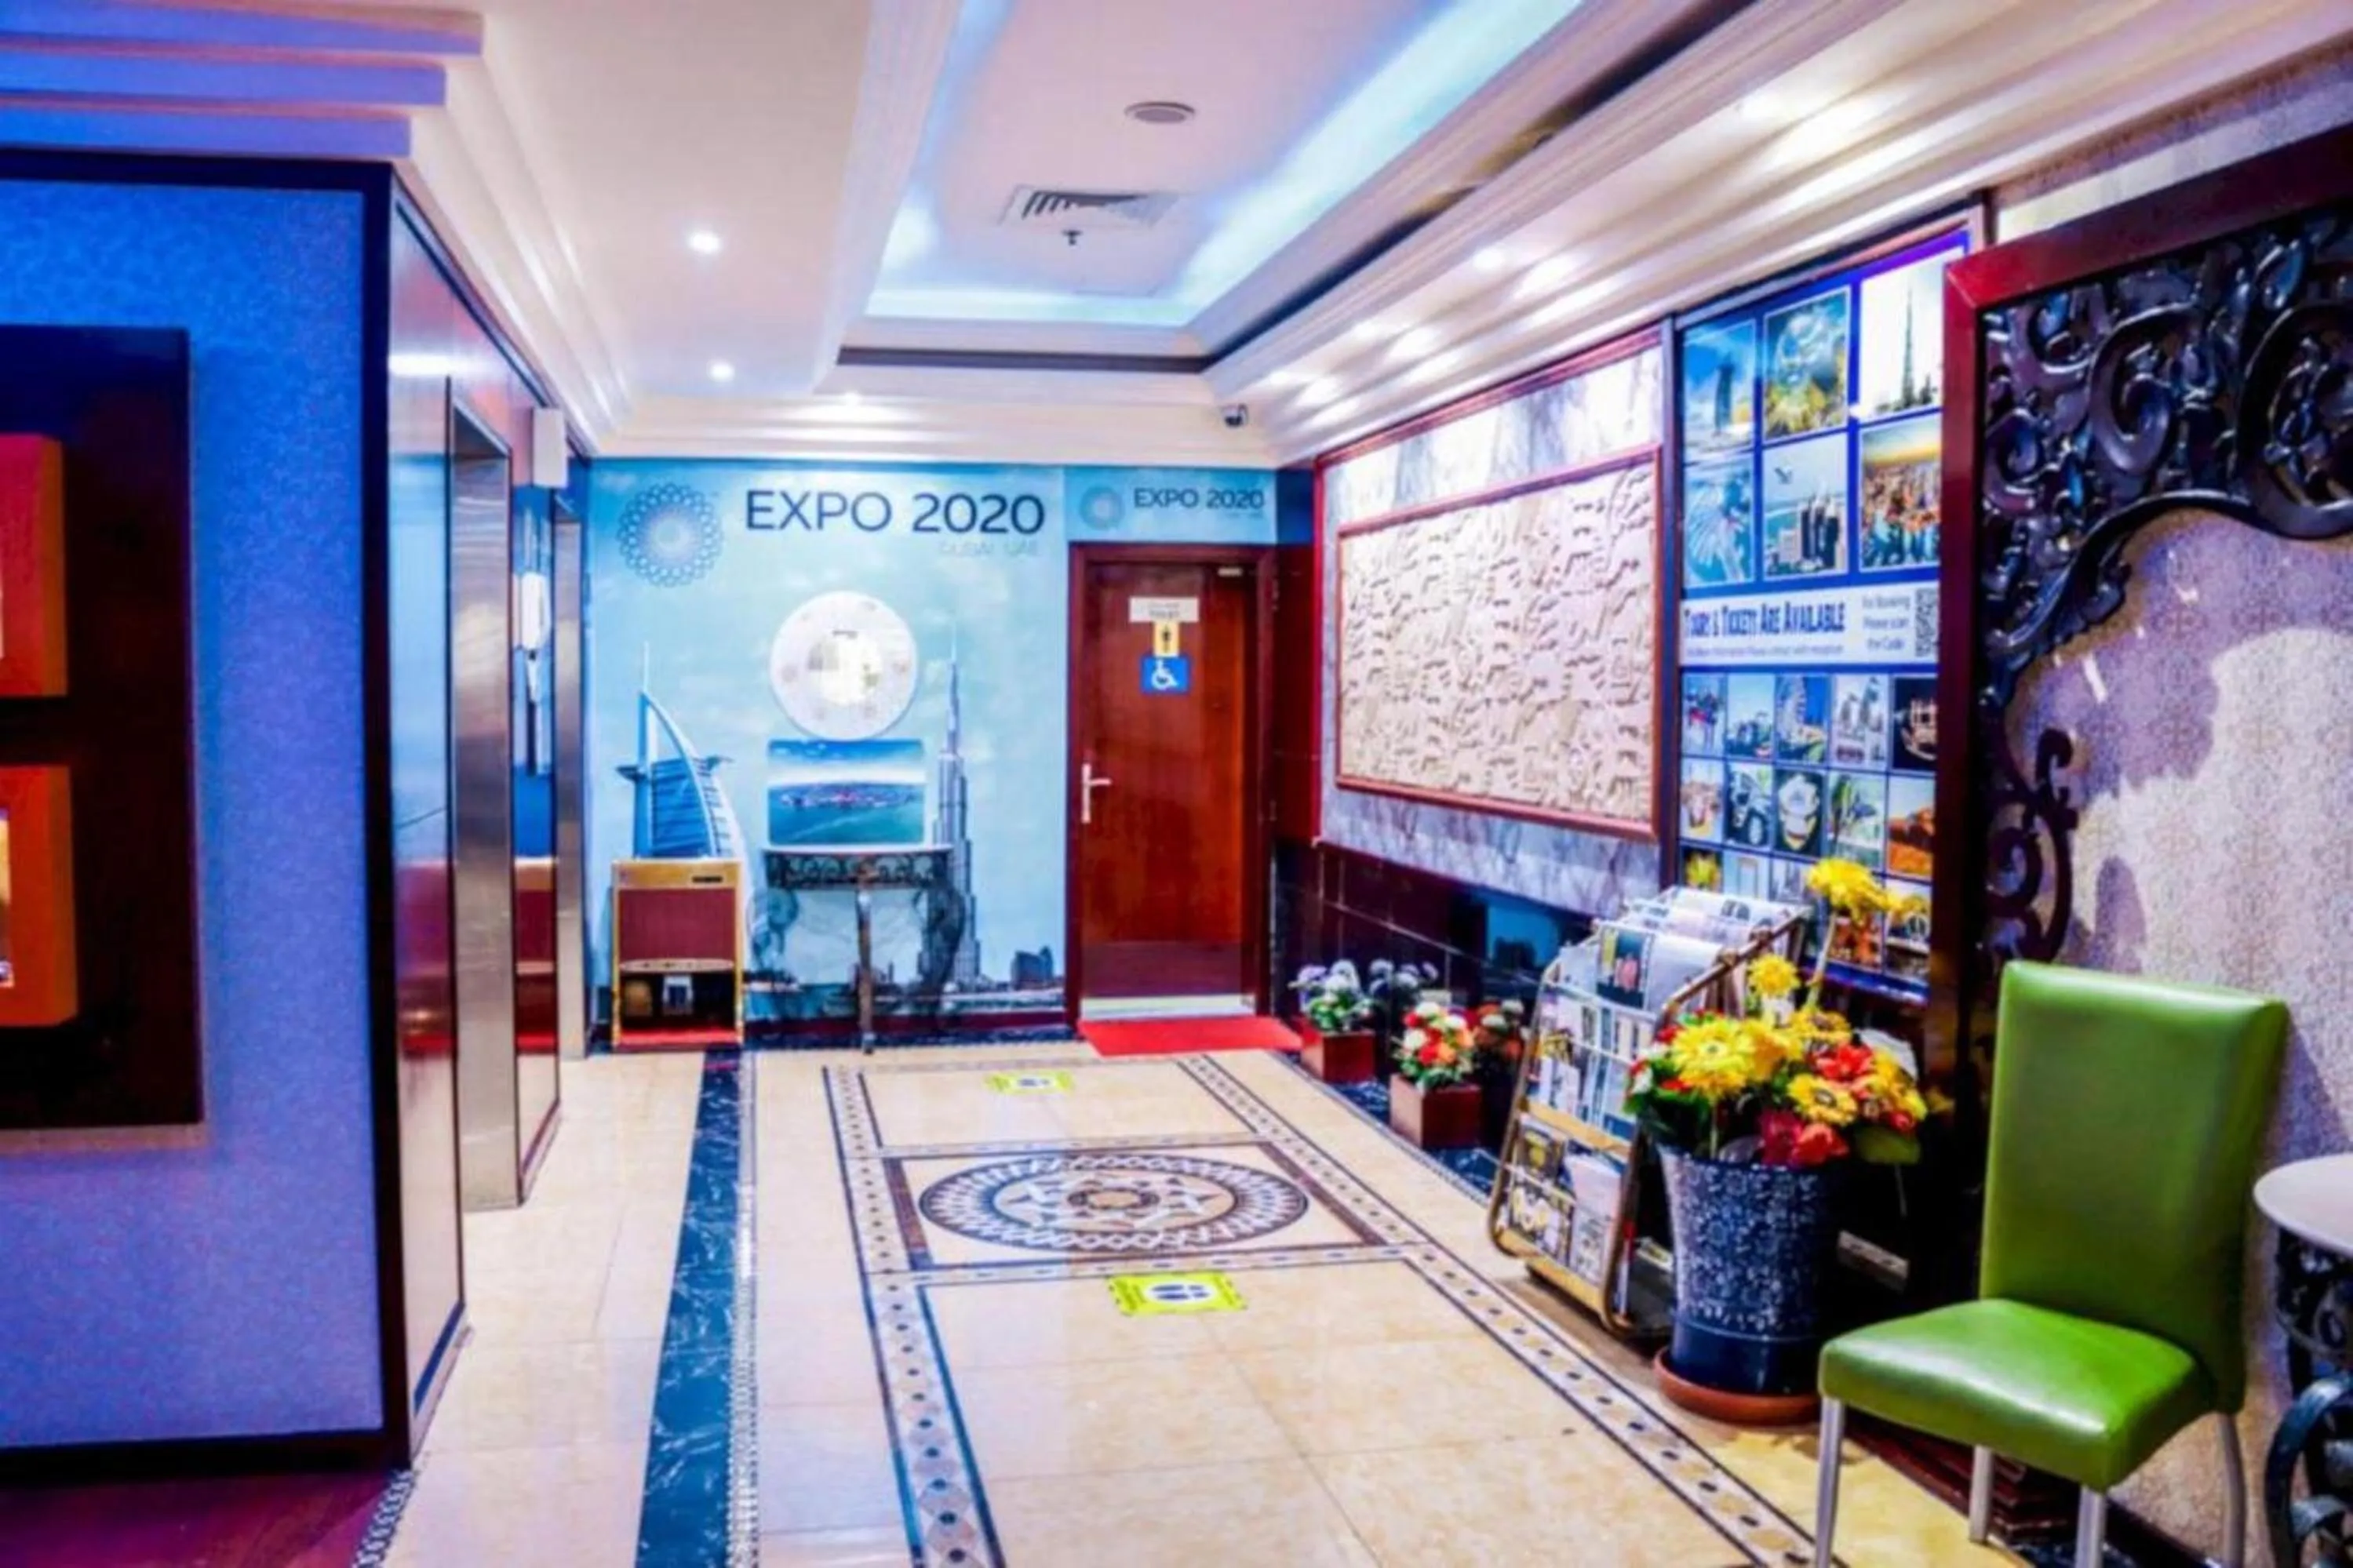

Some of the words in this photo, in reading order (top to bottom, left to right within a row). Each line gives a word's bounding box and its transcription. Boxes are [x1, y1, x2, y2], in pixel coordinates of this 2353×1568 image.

[746, 489, 892, 533] EXPO
[912, 493, 1045, 535] 2020
[1134, 487, 1199, 508] EXPO
[1206, 489, 1264, 509] 2020
